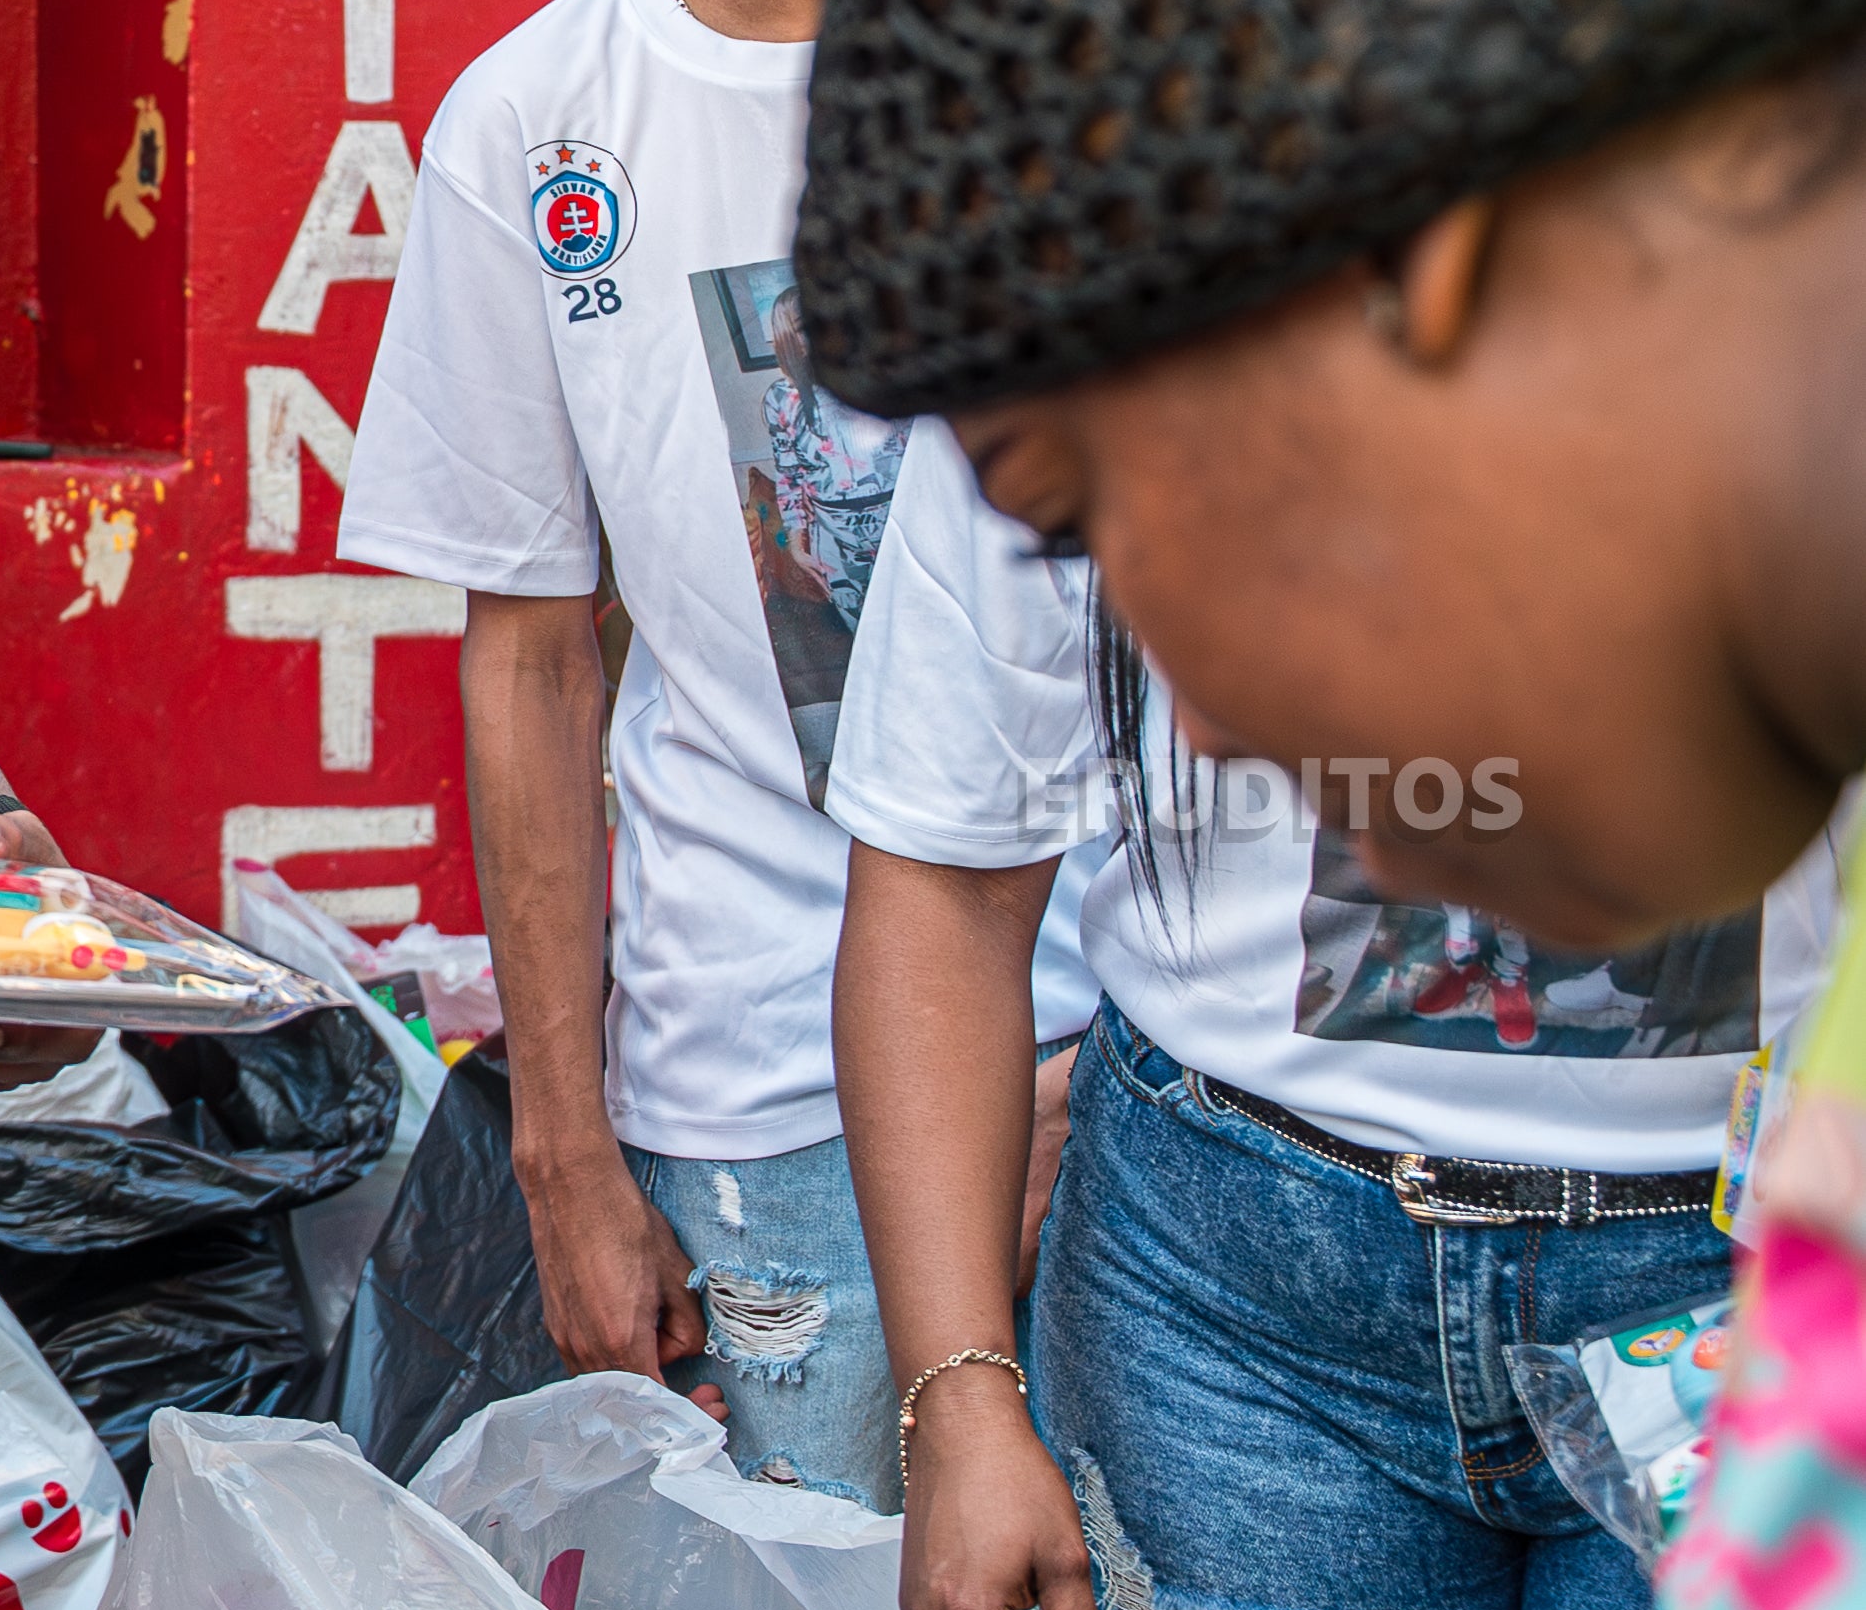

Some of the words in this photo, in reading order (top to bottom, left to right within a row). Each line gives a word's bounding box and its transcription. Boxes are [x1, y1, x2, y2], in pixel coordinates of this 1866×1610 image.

[550, 183, 597, 199] SLOVAN
[550, 234, 608, 265] BRATISLAVA
[561, 278, 622, 324] 28
